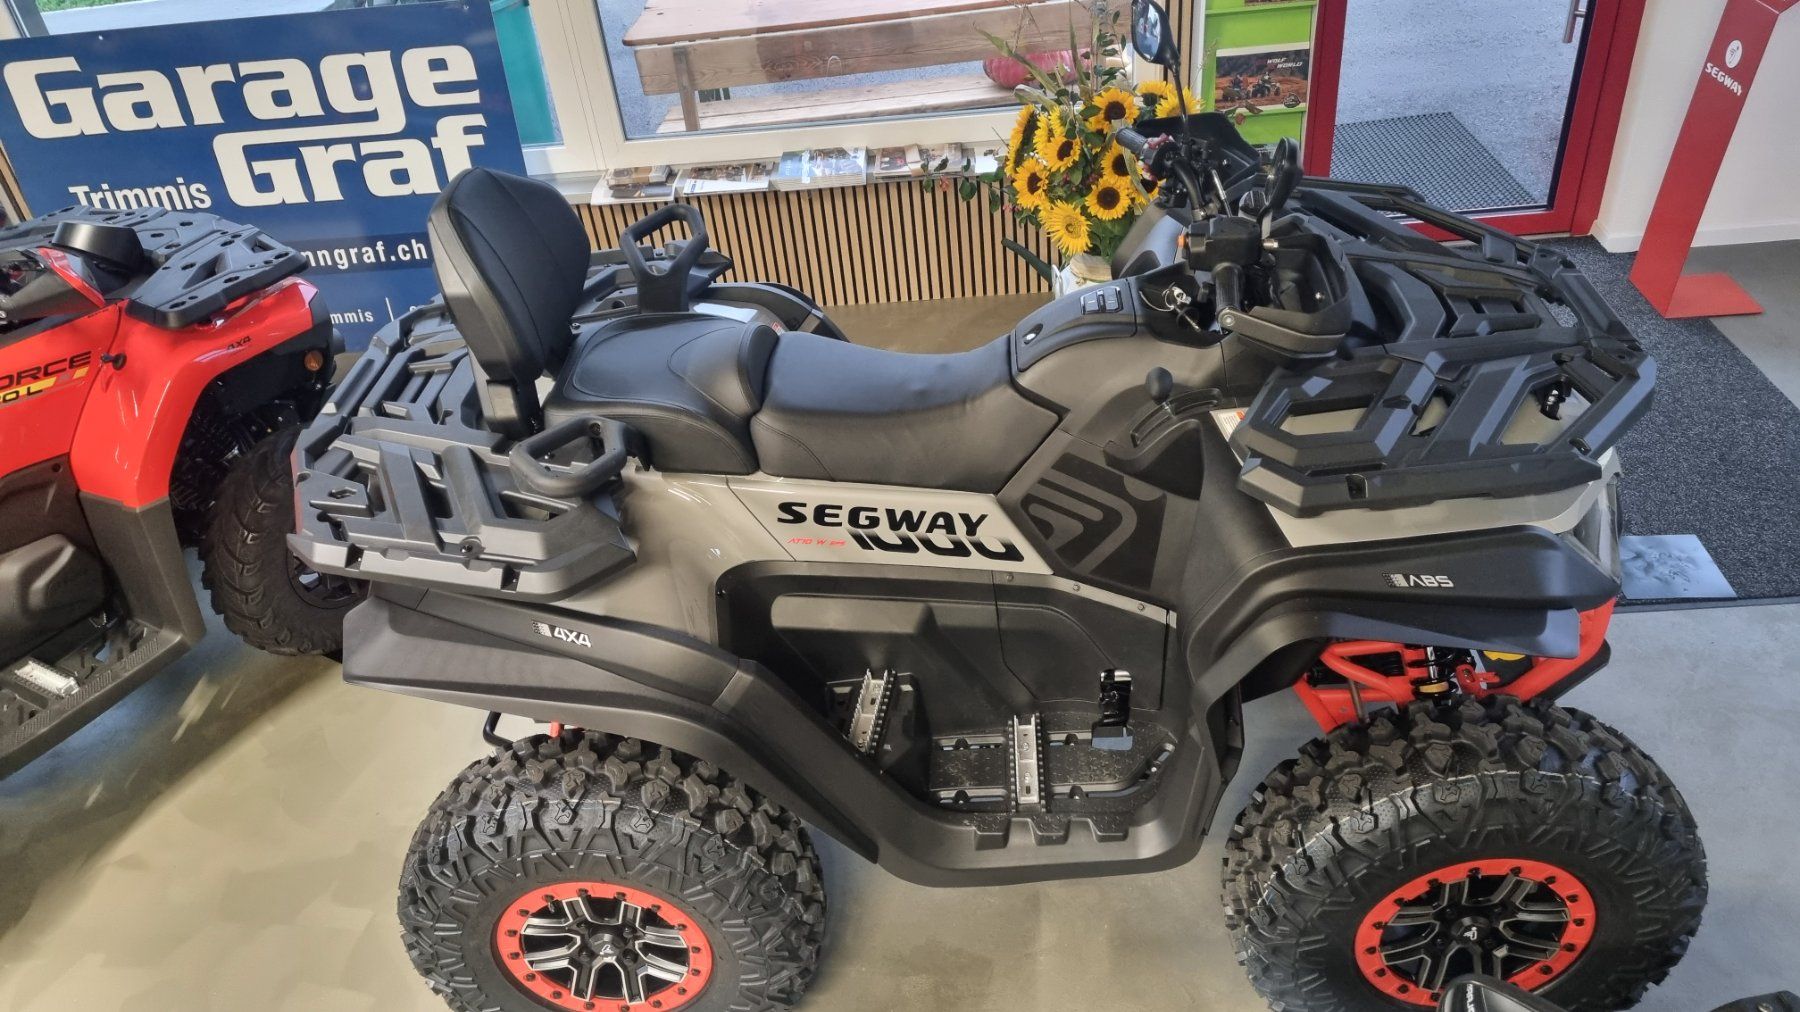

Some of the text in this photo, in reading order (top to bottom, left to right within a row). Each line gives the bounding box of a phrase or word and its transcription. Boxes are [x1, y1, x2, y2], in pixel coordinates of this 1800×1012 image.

[1267, 57, 1287, 65] WOLF
[1276, 61, 1303, 69] WORLD
[3, 44, 481, 140] Garage
[1705, 62, 1742, 97] SEGWAY
[212, 113, 487, 208] Graf
[68, 177, 212, 211] Trimmis
[776, 501, 989, 537] SEGWAY
[1409, 574, 1454, 588] ABS
[553, 626, 592, 648] 4X4
